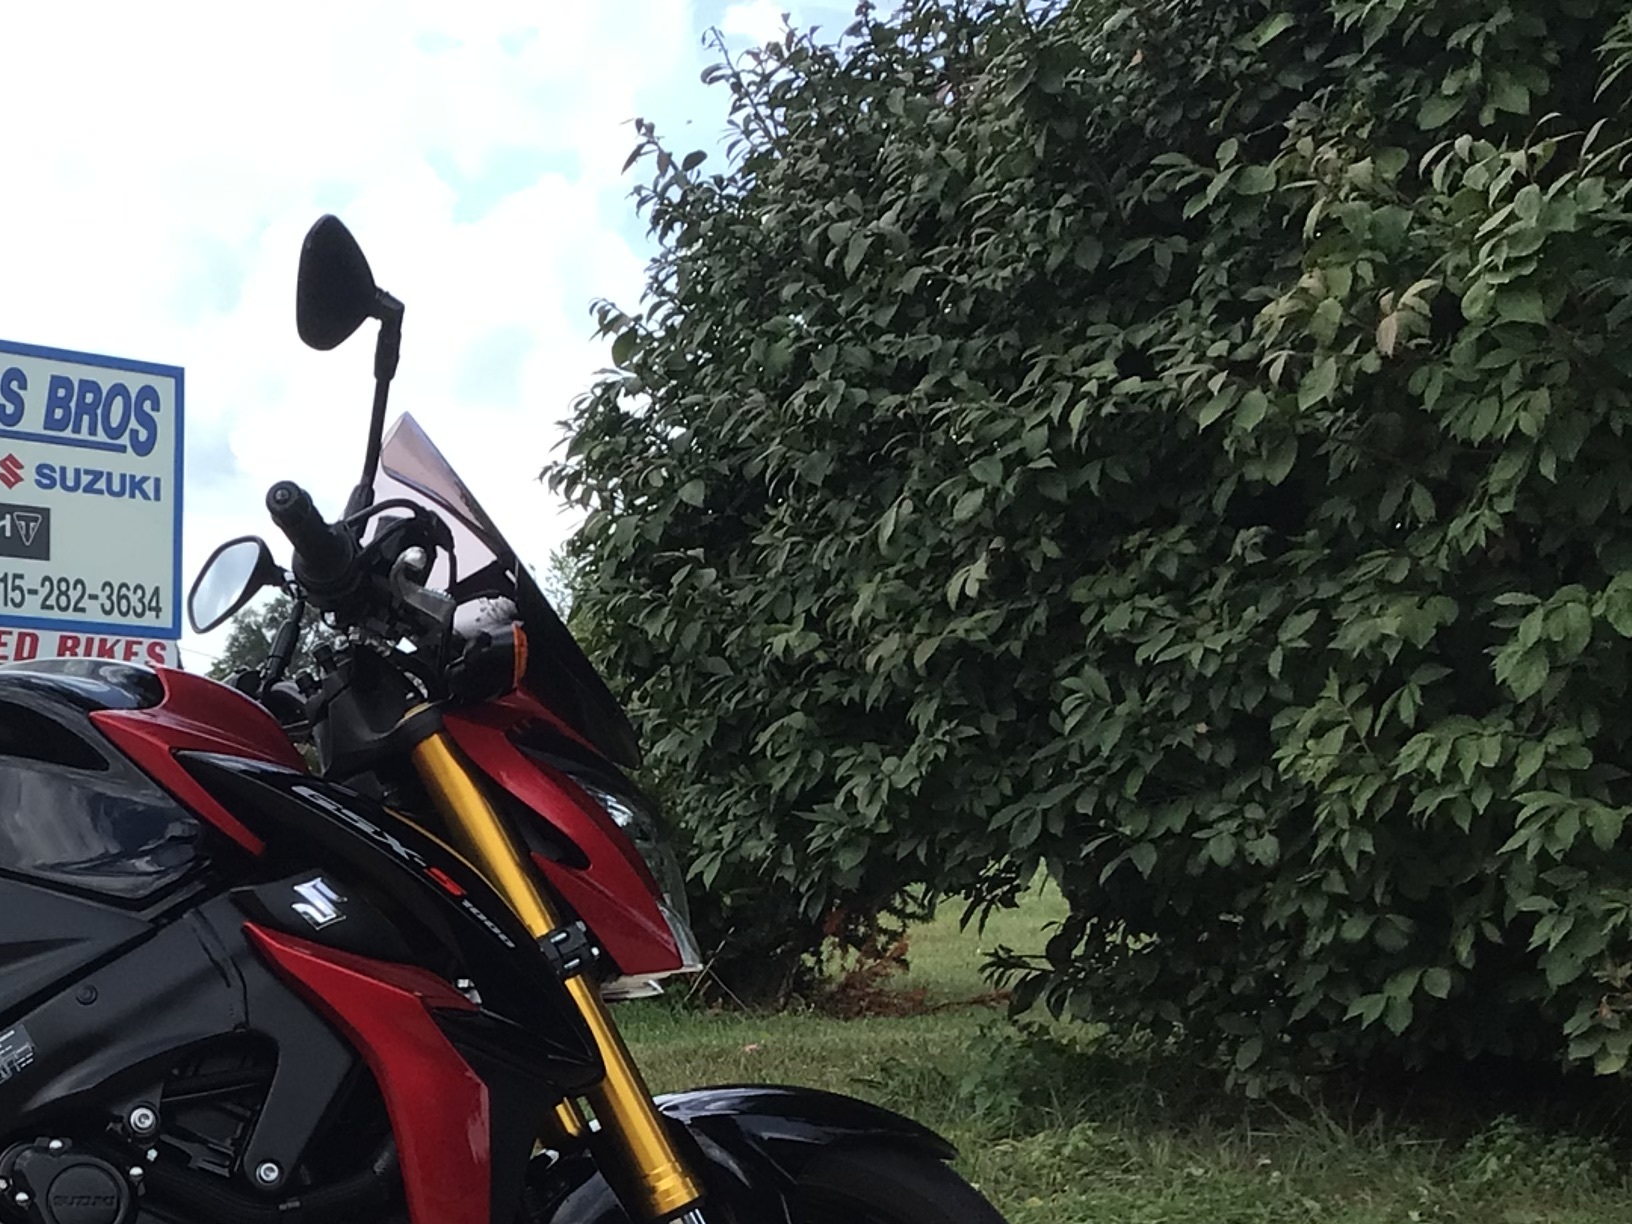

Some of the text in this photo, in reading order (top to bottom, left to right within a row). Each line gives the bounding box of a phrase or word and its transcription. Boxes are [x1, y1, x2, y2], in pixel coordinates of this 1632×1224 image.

[43, 374, 161, 457] BROS
[34, 463, 162, 502] SUZUKI
[56, 634, 167, 665] BIKES
